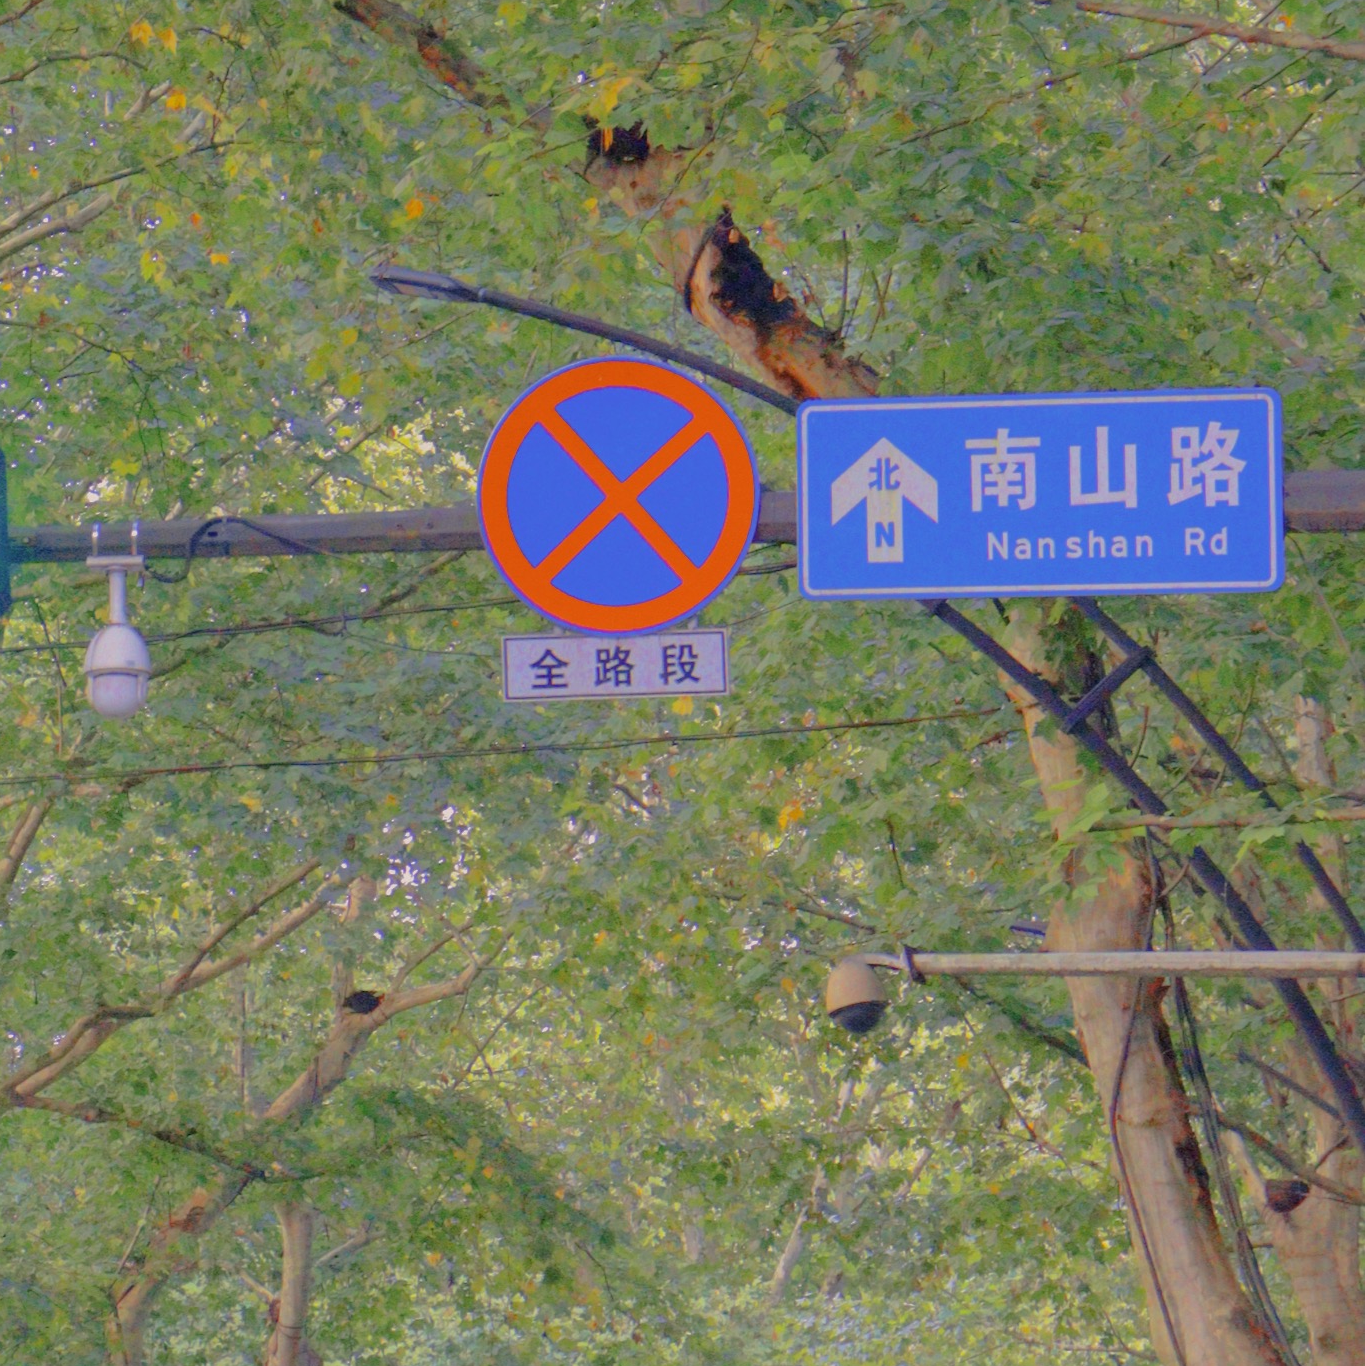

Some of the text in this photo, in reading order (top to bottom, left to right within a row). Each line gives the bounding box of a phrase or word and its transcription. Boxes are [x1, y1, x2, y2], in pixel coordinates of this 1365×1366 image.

[868, 457, 902, 492] 北
[964, 420, 1247, 513] 南山路
[874, 520, 897, 549] N
[986, 525, 1229, 561] Nanshan Rd
[529, 640, 701, 690] 全路段
